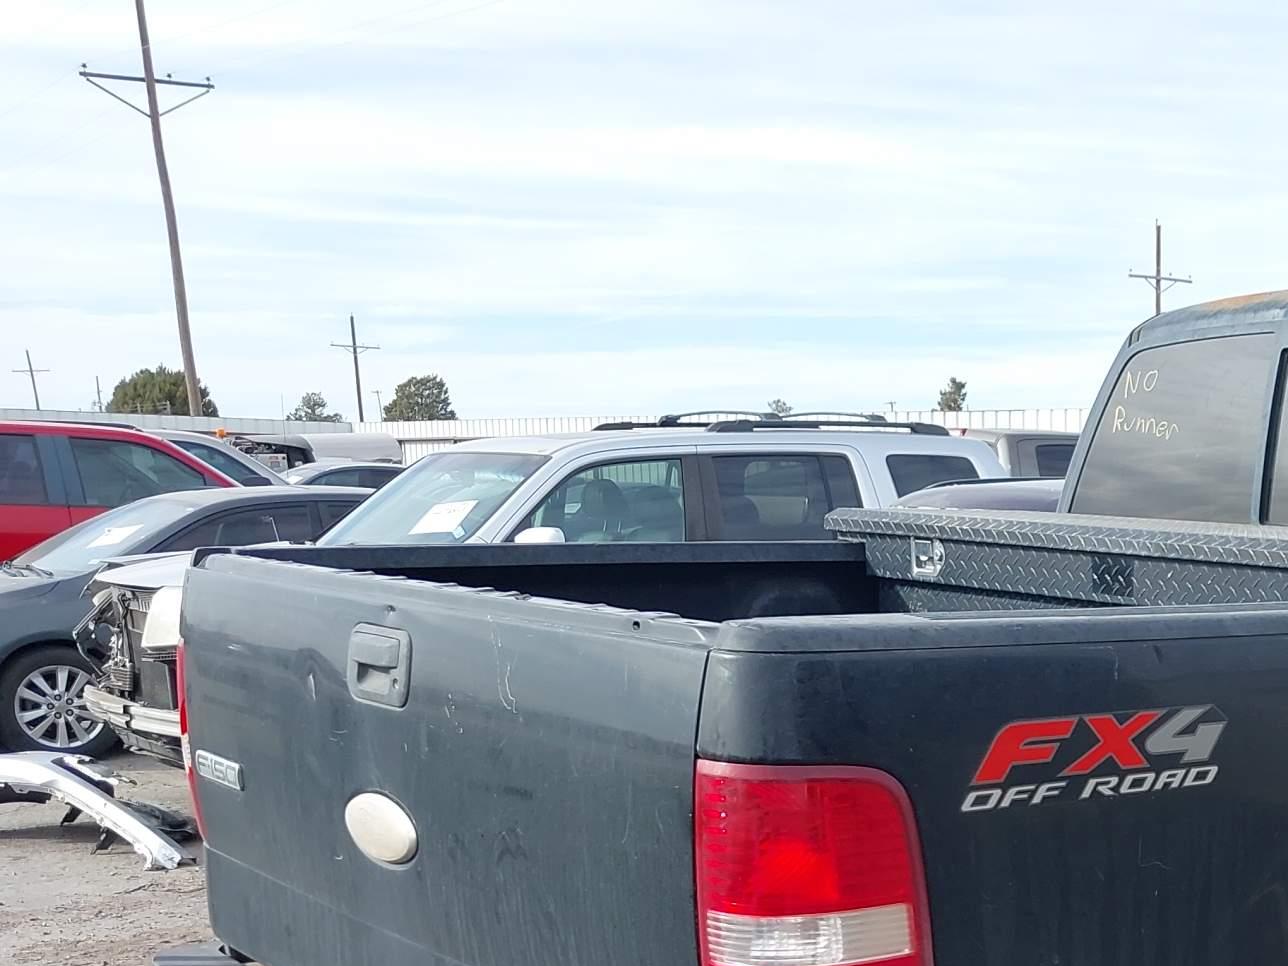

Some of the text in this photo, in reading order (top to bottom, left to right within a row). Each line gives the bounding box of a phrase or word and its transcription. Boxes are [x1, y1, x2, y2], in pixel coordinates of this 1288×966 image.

[1124, 369, 1159, 399] NO
[1112, 406, 1180, 440] Runner
[971, 704, 1229, 785] FX4
[961, 764, 1220, 813] OFF ROAD
